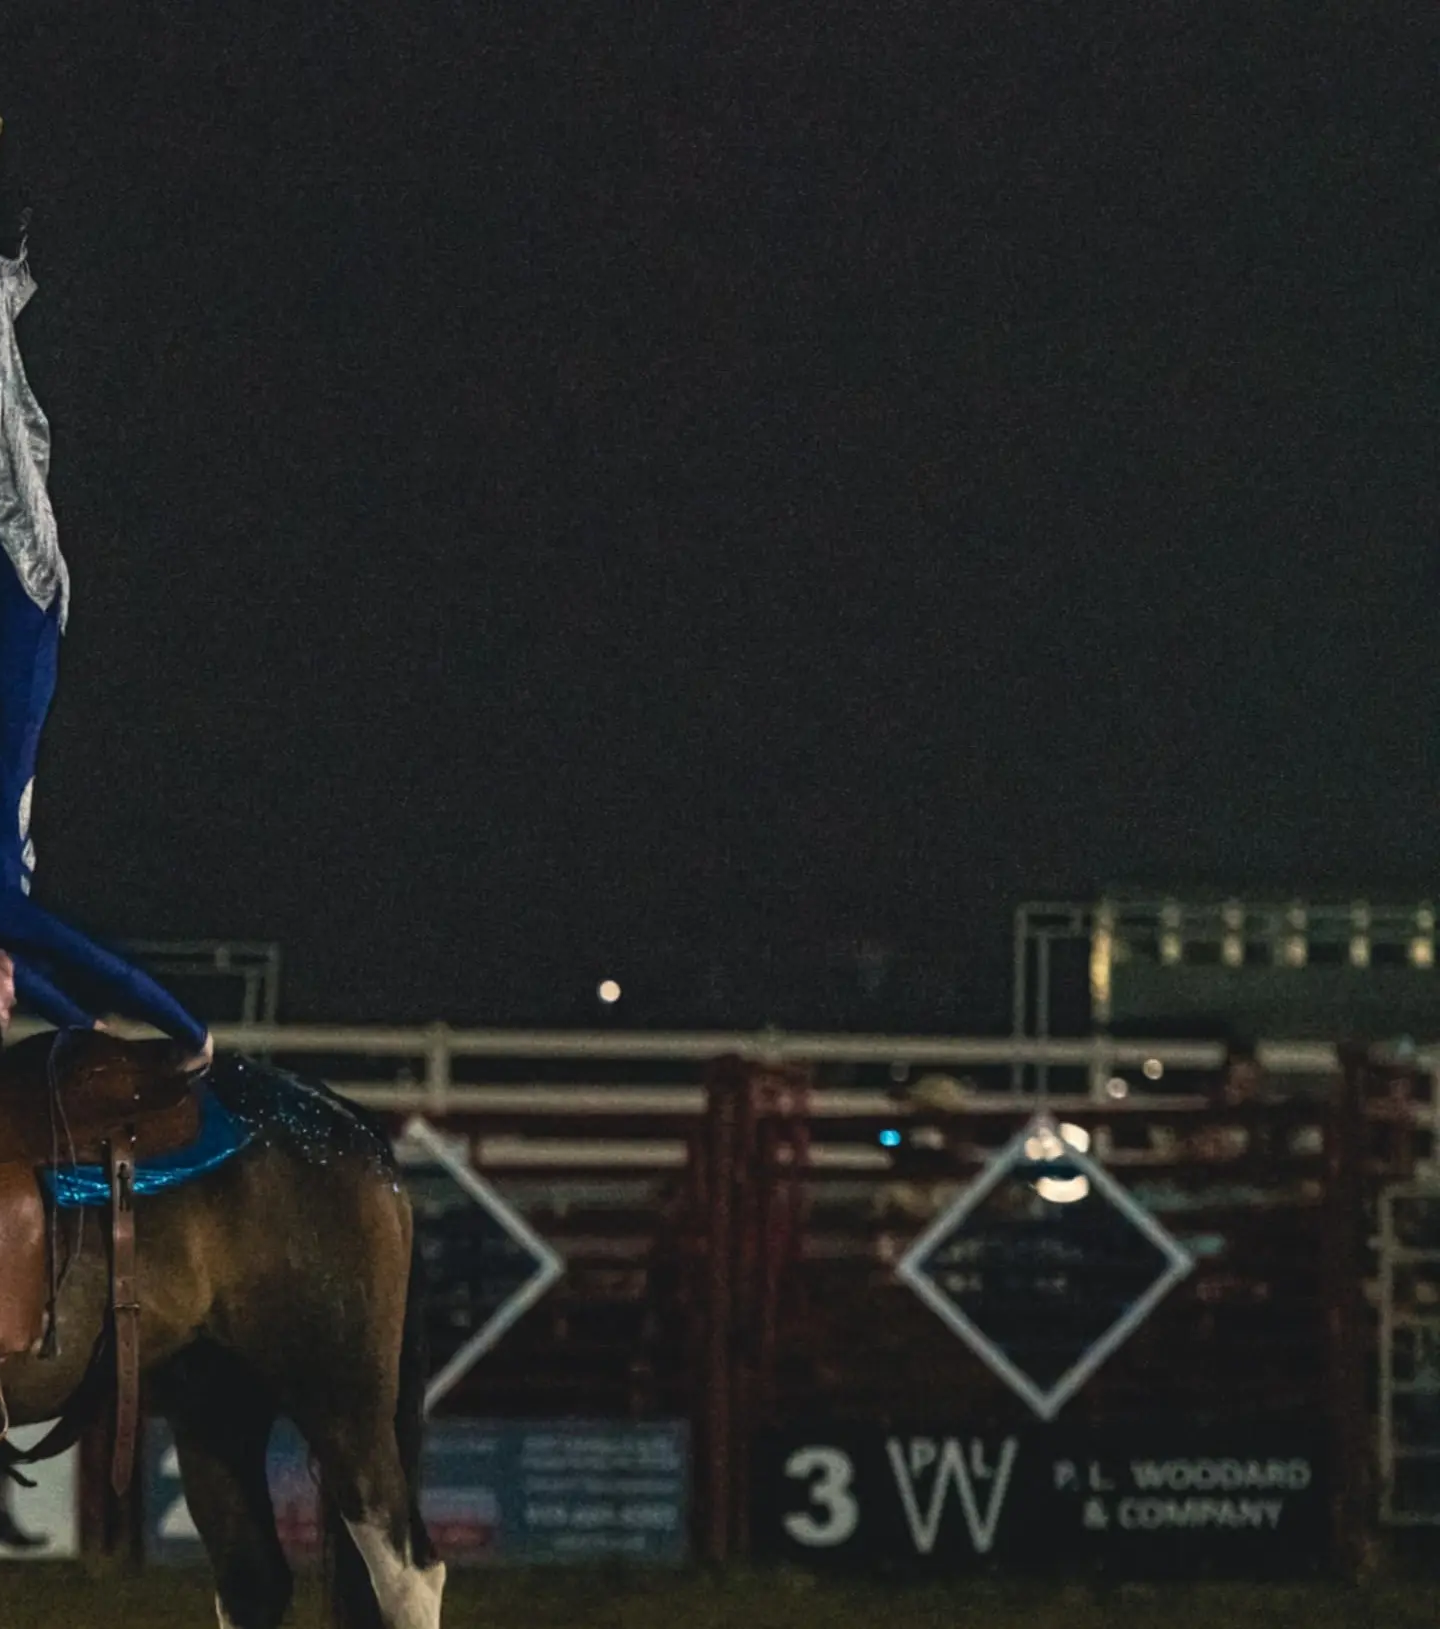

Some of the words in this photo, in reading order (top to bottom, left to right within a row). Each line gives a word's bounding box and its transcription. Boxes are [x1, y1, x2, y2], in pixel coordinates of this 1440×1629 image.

[1128, 1457, 1312, 1491] WOODARD
[782, 1444, 859, 1547] 3
[1116, 1496, 1284, 1530] COMPANY
